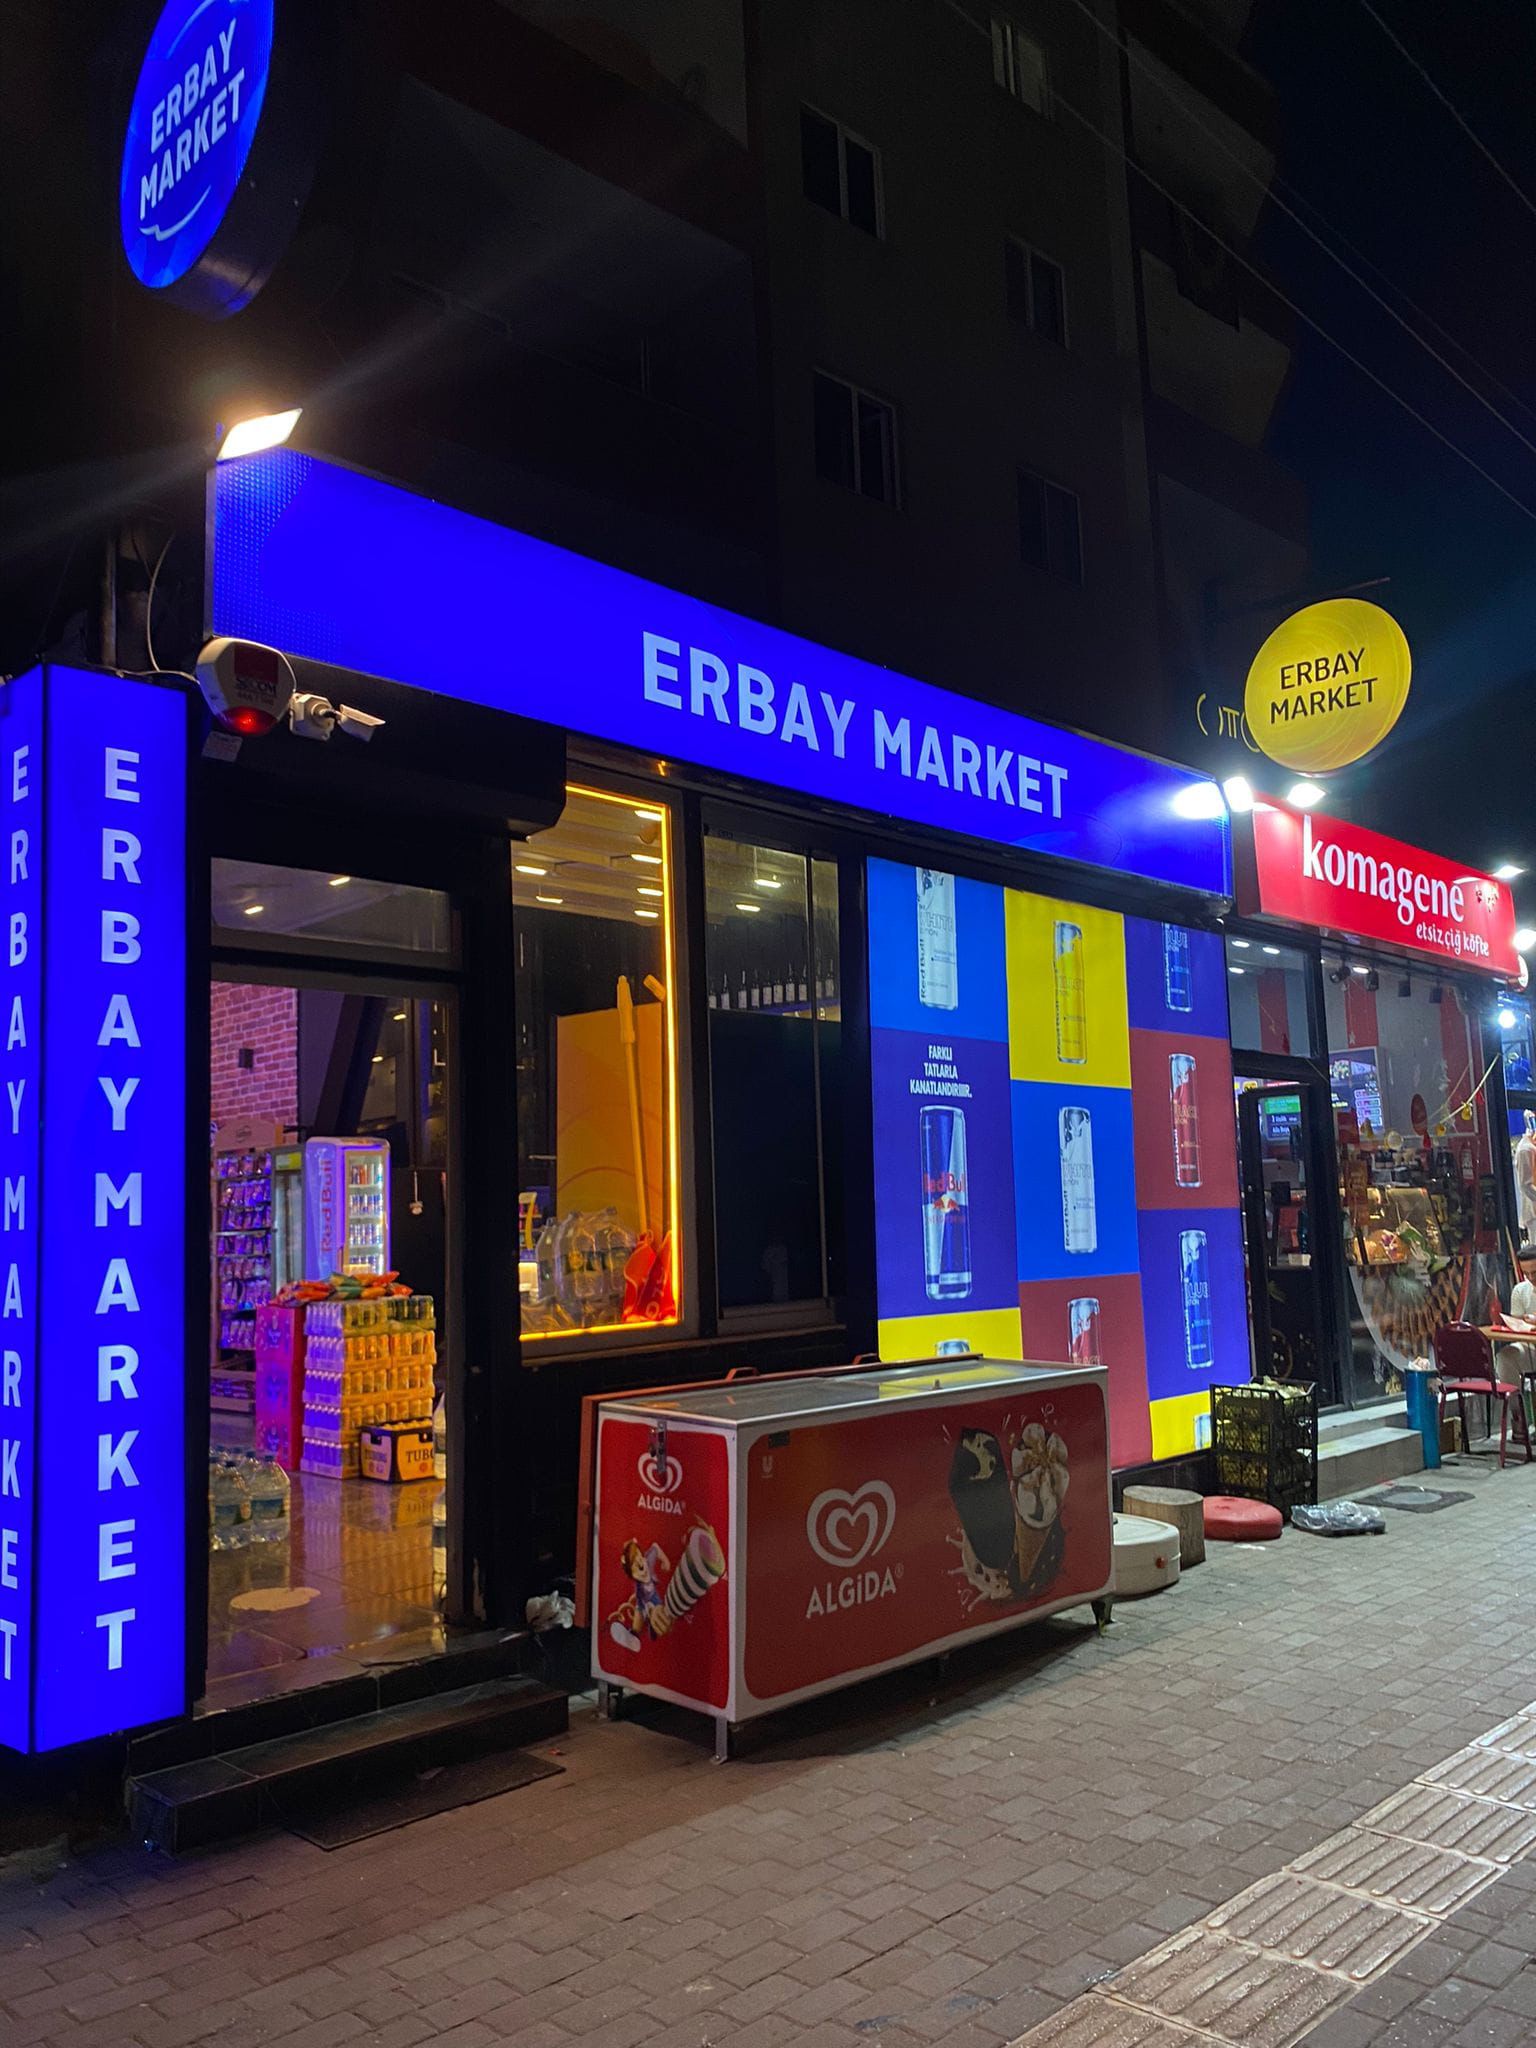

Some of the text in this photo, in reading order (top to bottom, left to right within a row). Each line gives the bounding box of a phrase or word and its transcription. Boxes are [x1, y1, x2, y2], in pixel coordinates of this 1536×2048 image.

[151, 17, 236, 154] ERBAY
[140, 67, 245, 221] MARKET
[1270, 677, 1378, 724] MARKET
[1280, 647, 1365, 690] ERBAY
[643, 631, 1069, 819] ERBAY MARKET
[1303, 814, 1464, 926] komagene
[1416, 921, 1489, 957] etsiz çiğ köfte
[923, 1062, 959, 1080] TATLARLA
[928, 1045, 953, 1061] FARKLI
[0, 745, 29, 1680] ERBAY MARKET
[94, 747, 142, 1670] ERBAY MARKET
